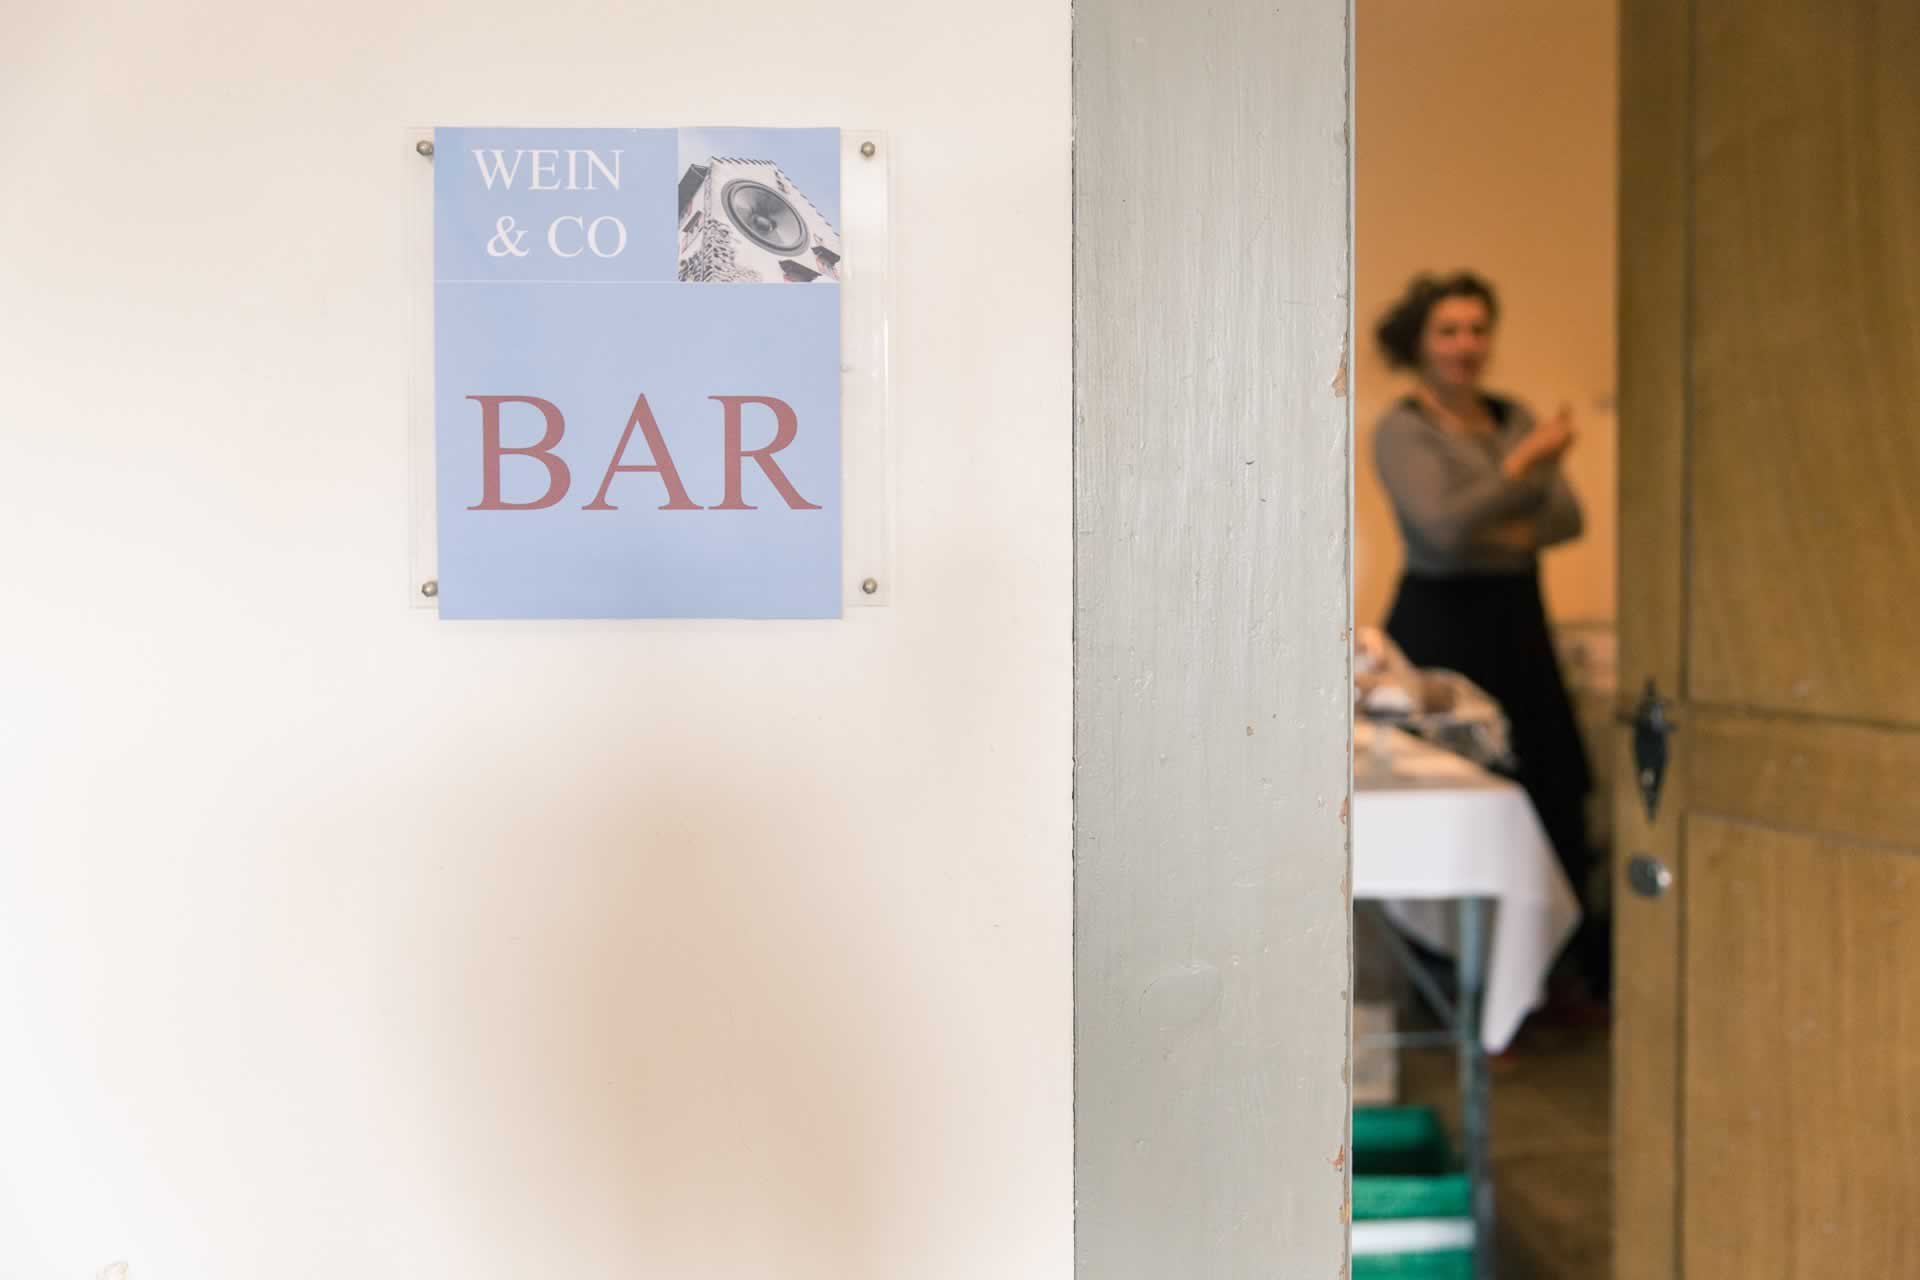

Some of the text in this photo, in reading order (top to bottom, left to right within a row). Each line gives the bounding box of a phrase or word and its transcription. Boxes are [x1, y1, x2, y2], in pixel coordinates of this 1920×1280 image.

[472, 148, 625, 191] WEIN
[486, 215, 628, 258] & CO
[465, 392, 823, 511] BAR
